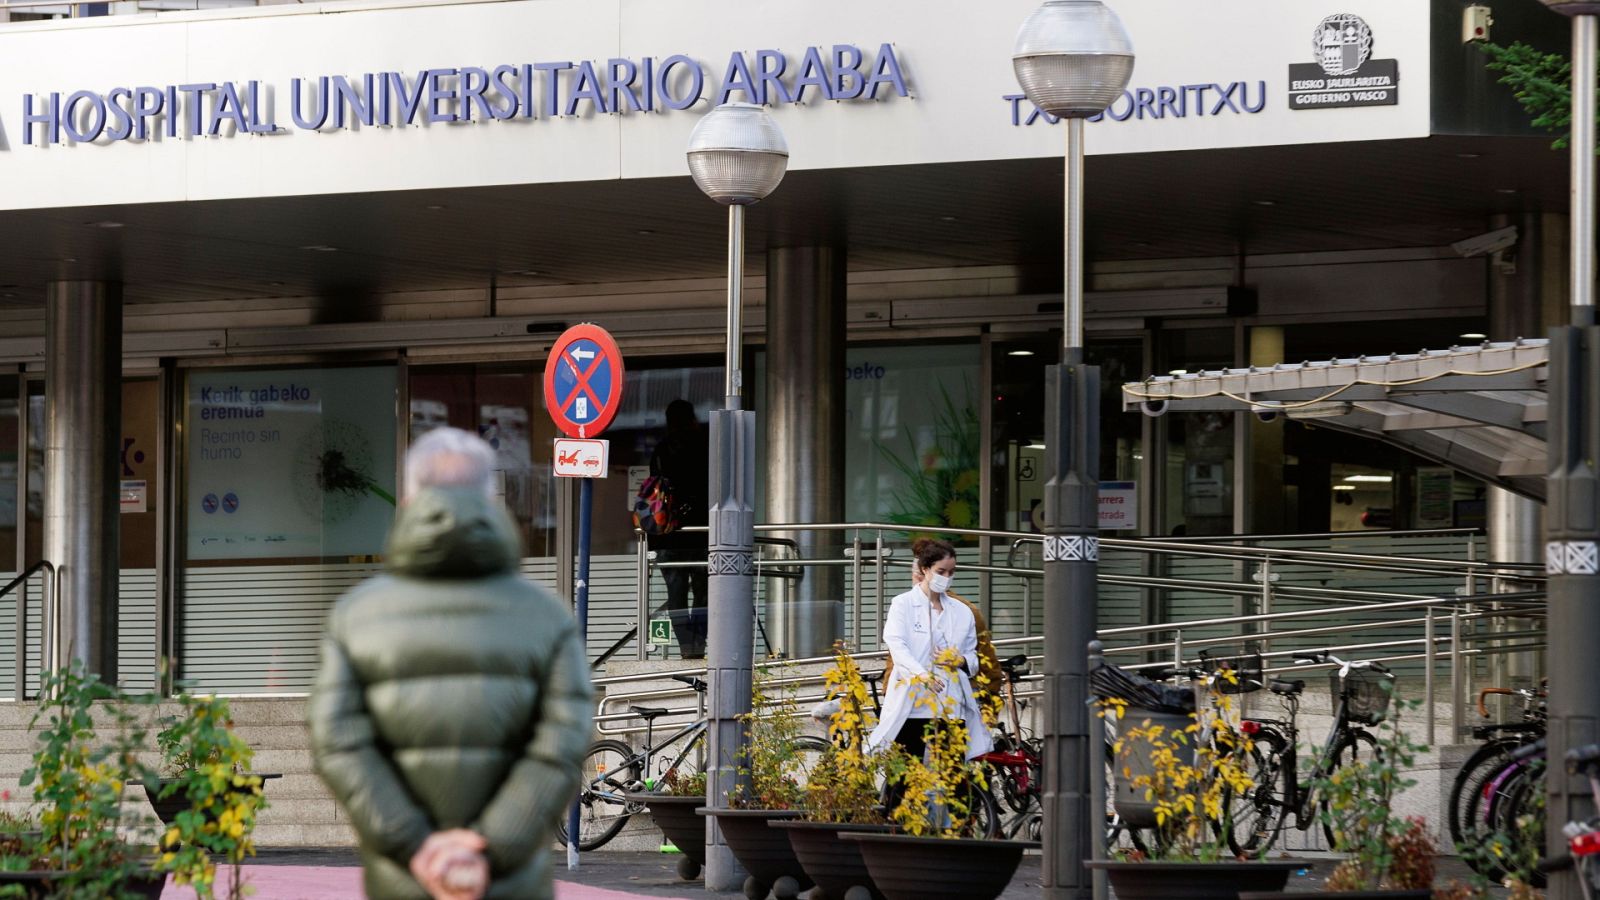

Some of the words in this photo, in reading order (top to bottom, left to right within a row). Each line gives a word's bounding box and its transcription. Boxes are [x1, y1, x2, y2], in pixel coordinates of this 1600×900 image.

[1292, 79, 1324, 89] EUSKO
[1326, 76, 1390, 90] JAURLARITZA
[23, 80, 277, 144] HOSPITAL
[291, 55, 704, 130] UNIVERSITARIO
[717, 43, 908, 104] ARABA
[1296, 92, 1350, 104] GOBIERNO
[1352, 91, 1387, 101] VASCO
[1003, 80, 1266, 126] TXORRITXU
[249, 384, 310, 405] gabeko
[201, 404, 264, 420] eremua
[201, 428, 256, 443] Recinto
[260, 428, 280, 442] sin
[201, 446, 242, 459] humo
